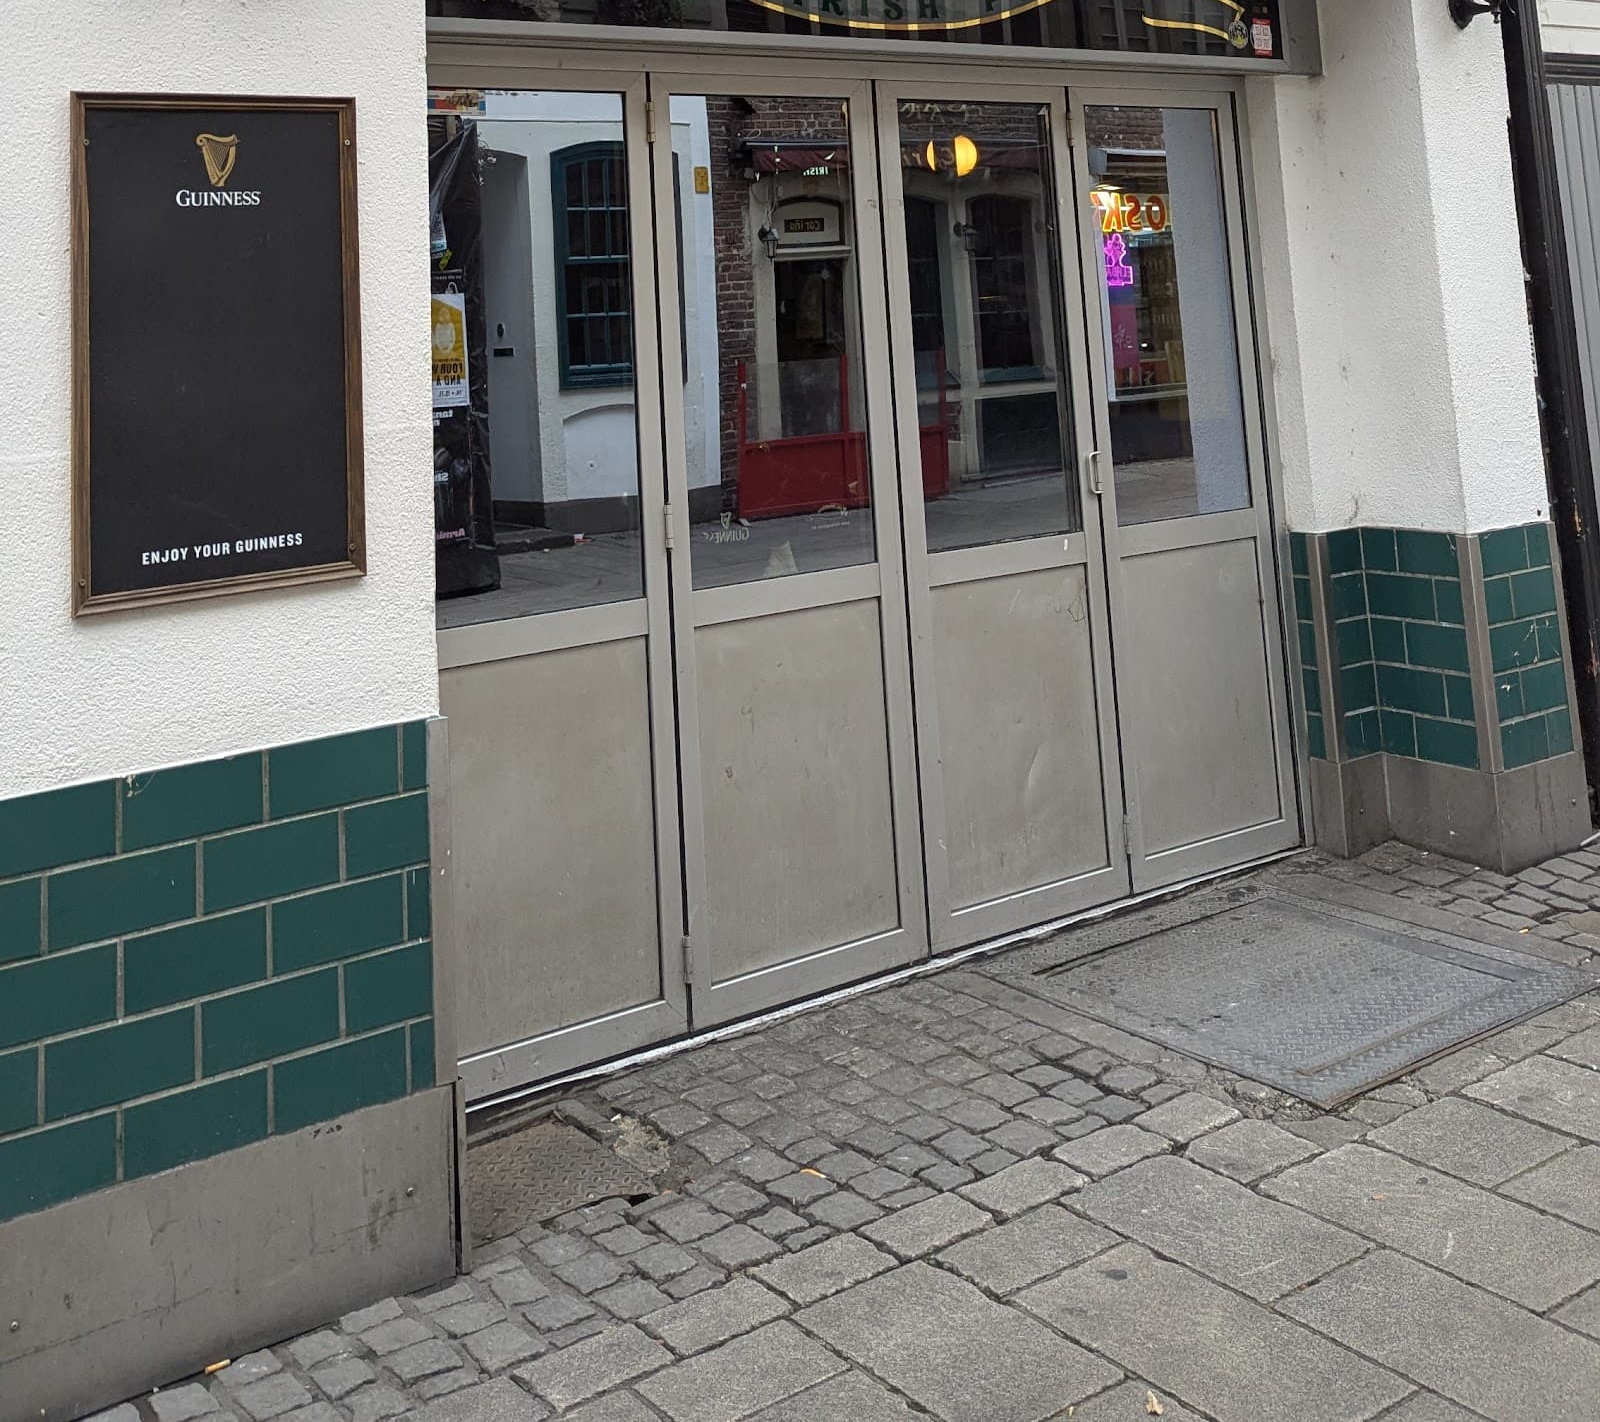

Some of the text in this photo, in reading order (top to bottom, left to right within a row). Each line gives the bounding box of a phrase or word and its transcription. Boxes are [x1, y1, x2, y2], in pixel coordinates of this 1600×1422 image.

[176, 189, 261, 207] GUINNESS
[141, 532, 304, 566] ENJOY YOUR GUINNESS
